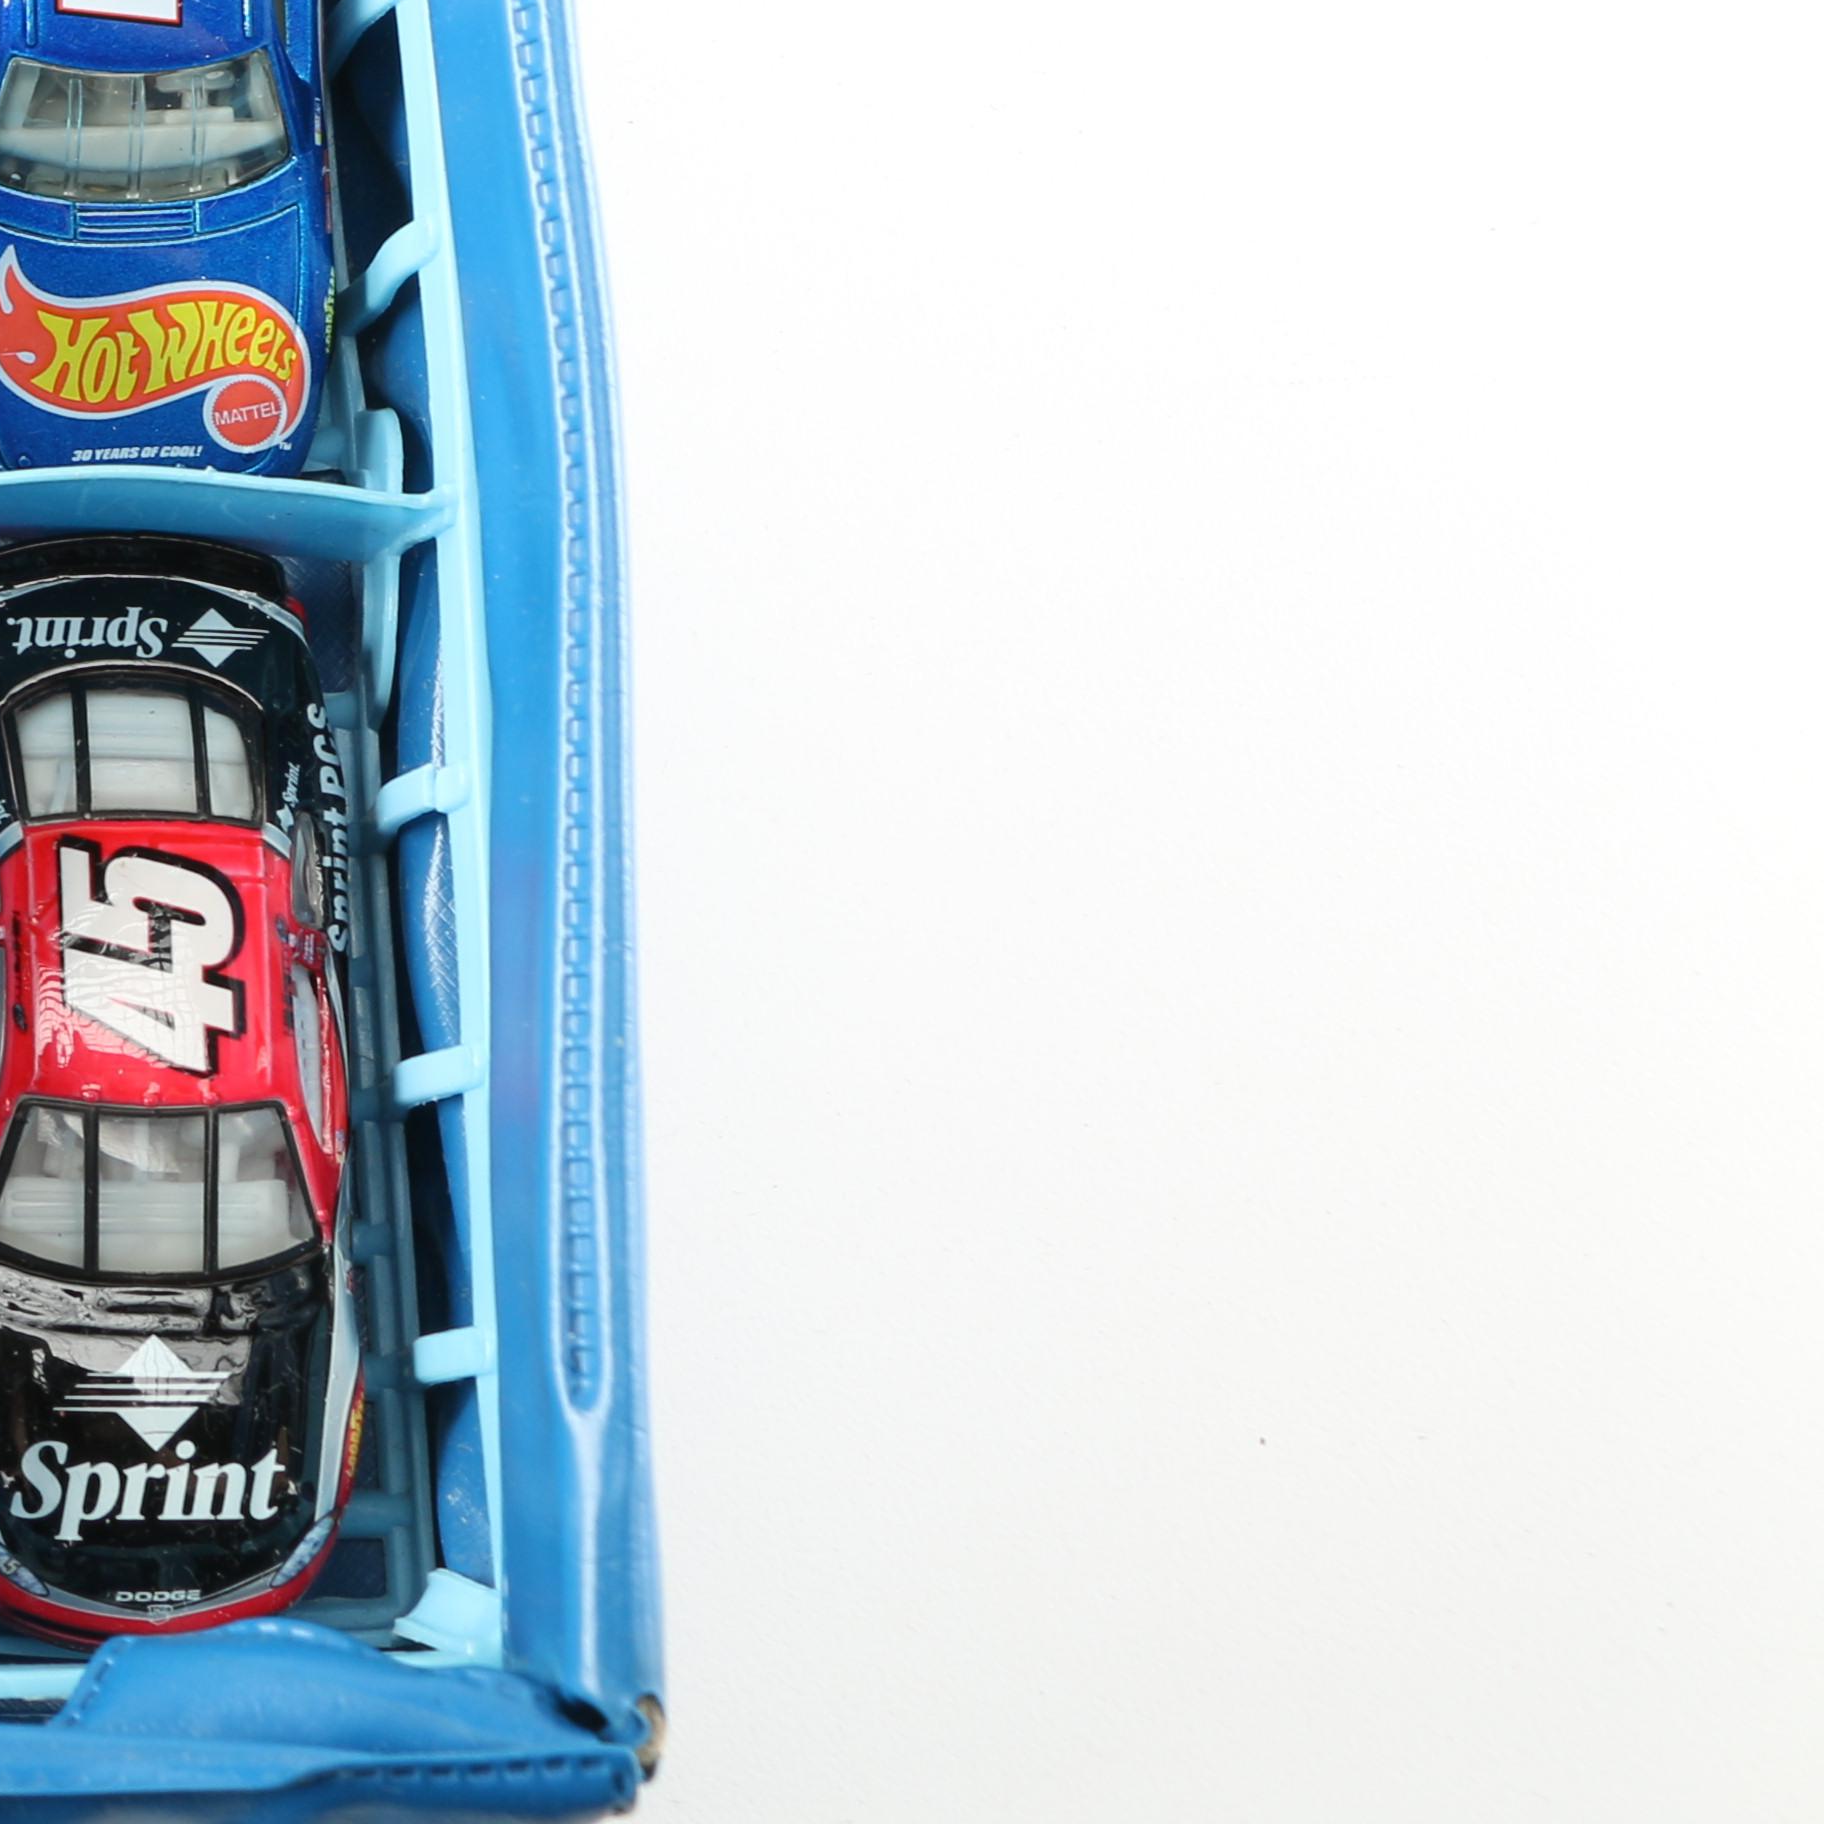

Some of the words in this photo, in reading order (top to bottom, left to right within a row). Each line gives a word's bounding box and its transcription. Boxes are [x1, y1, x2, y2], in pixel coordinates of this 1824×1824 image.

[72, 449, 92, 462] 30
[94, 448, 140, 461] YEARS
[141, 447, 158, 459] OF
[160, 445, 203, 458] COOL!
[214, 402, 282, 426] MATTEL
[307, 704, 342, 793] PCS
[319, 798, 349, 954] Sprint
[60, 833, 245, 1078] 45
[10, 1441, 286, 1542] Sprint
[115, 1588, 201, 1601] DODGE
